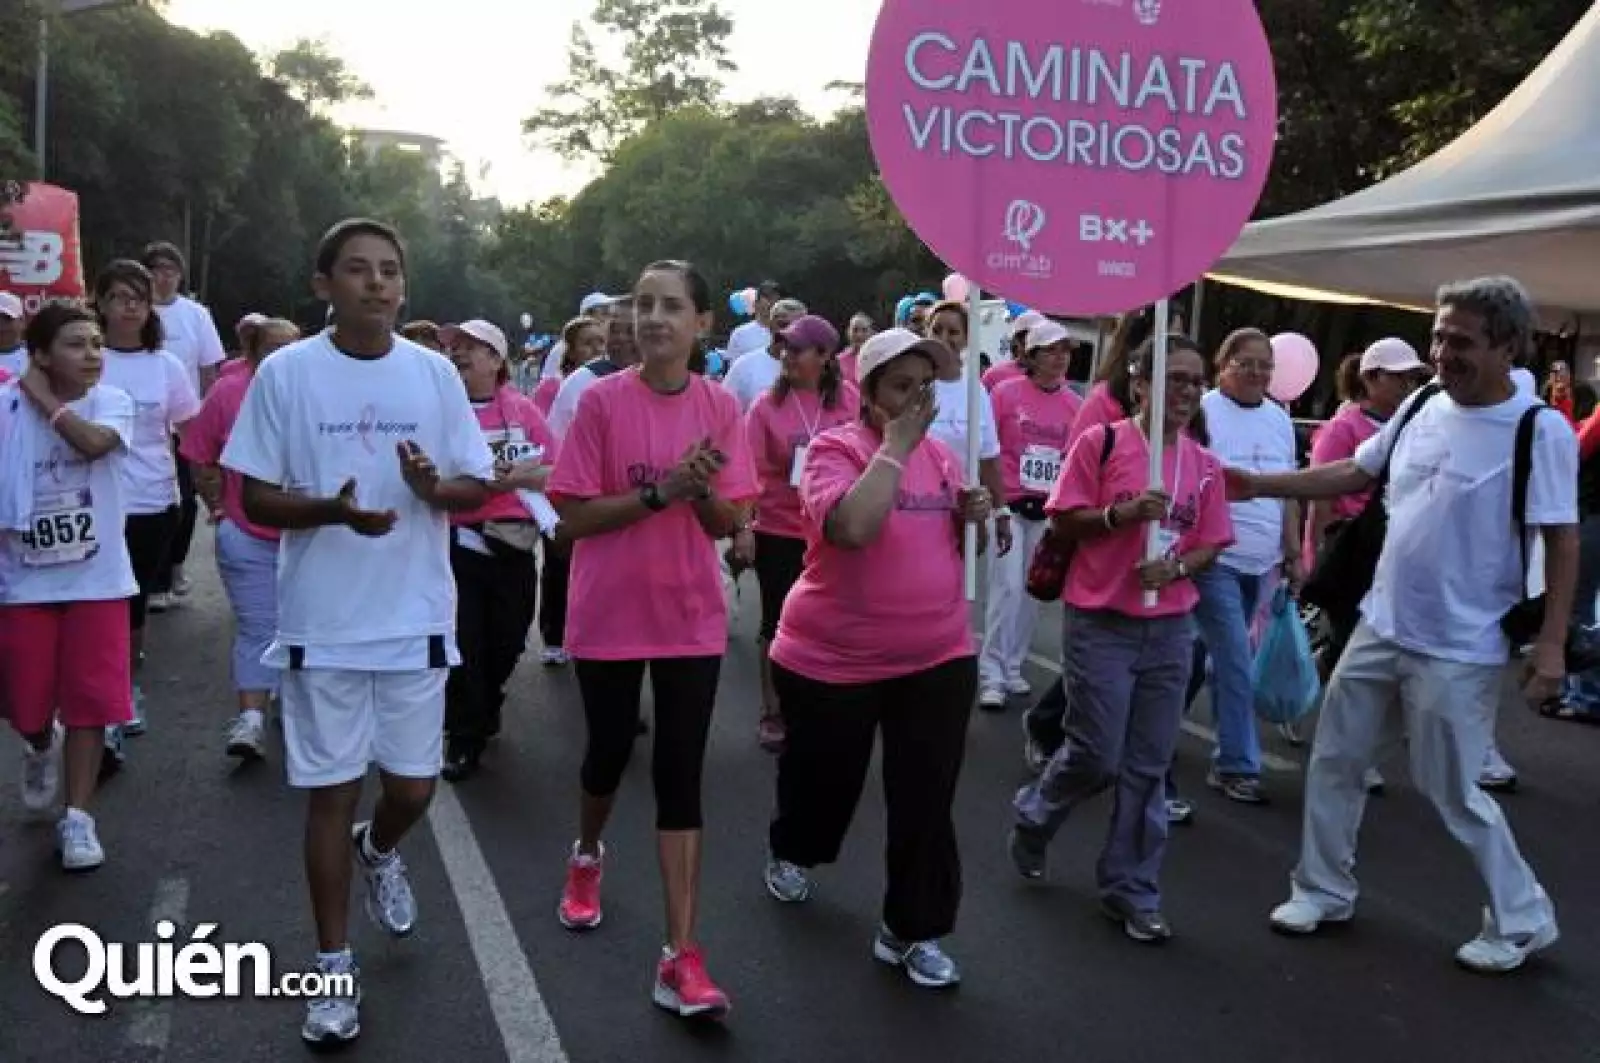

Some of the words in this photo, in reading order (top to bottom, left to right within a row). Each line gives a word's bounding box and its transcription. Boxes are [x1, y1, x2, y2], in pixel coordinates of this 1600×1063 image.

[904, 32, 1246, 118] CAMINATA
[903, 104, 1245, 179] VICTORIOSAS
[22, 512, 96, 550] 4952
